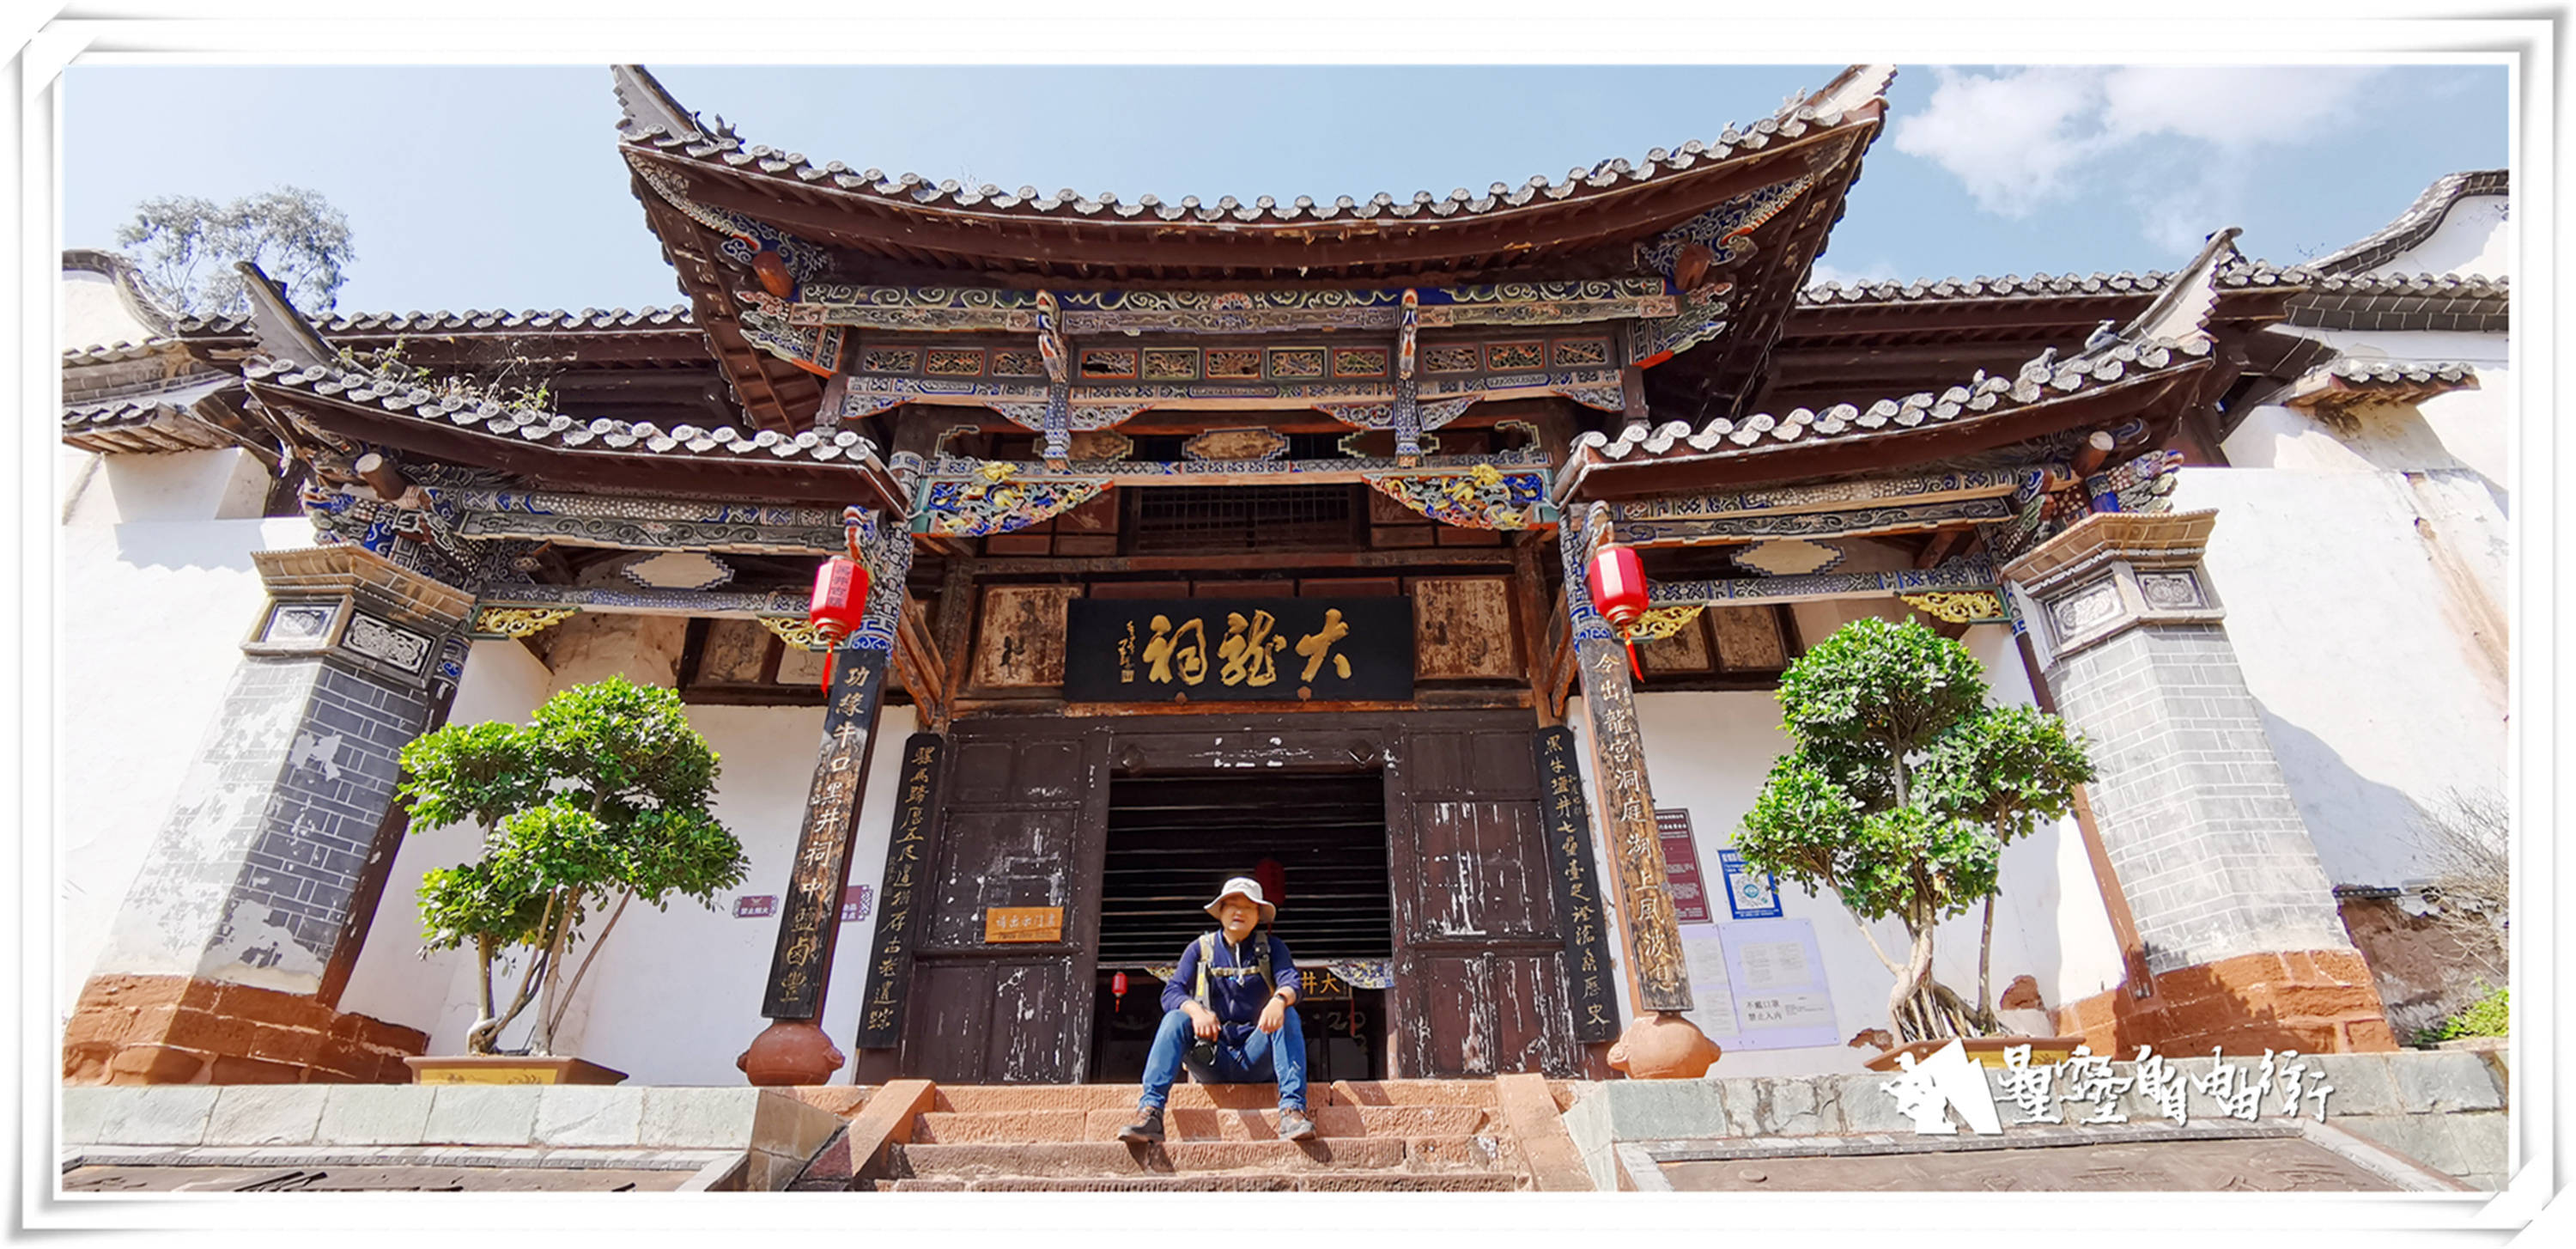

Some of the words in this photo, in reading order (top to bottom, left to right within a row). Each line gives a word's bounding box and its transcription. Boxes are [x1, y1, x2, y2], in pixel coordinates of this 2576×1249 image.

[1746, 999, 1779, 1009] 不戴口罩
[1748, 1011, 1783, 1021] 禁止入内
